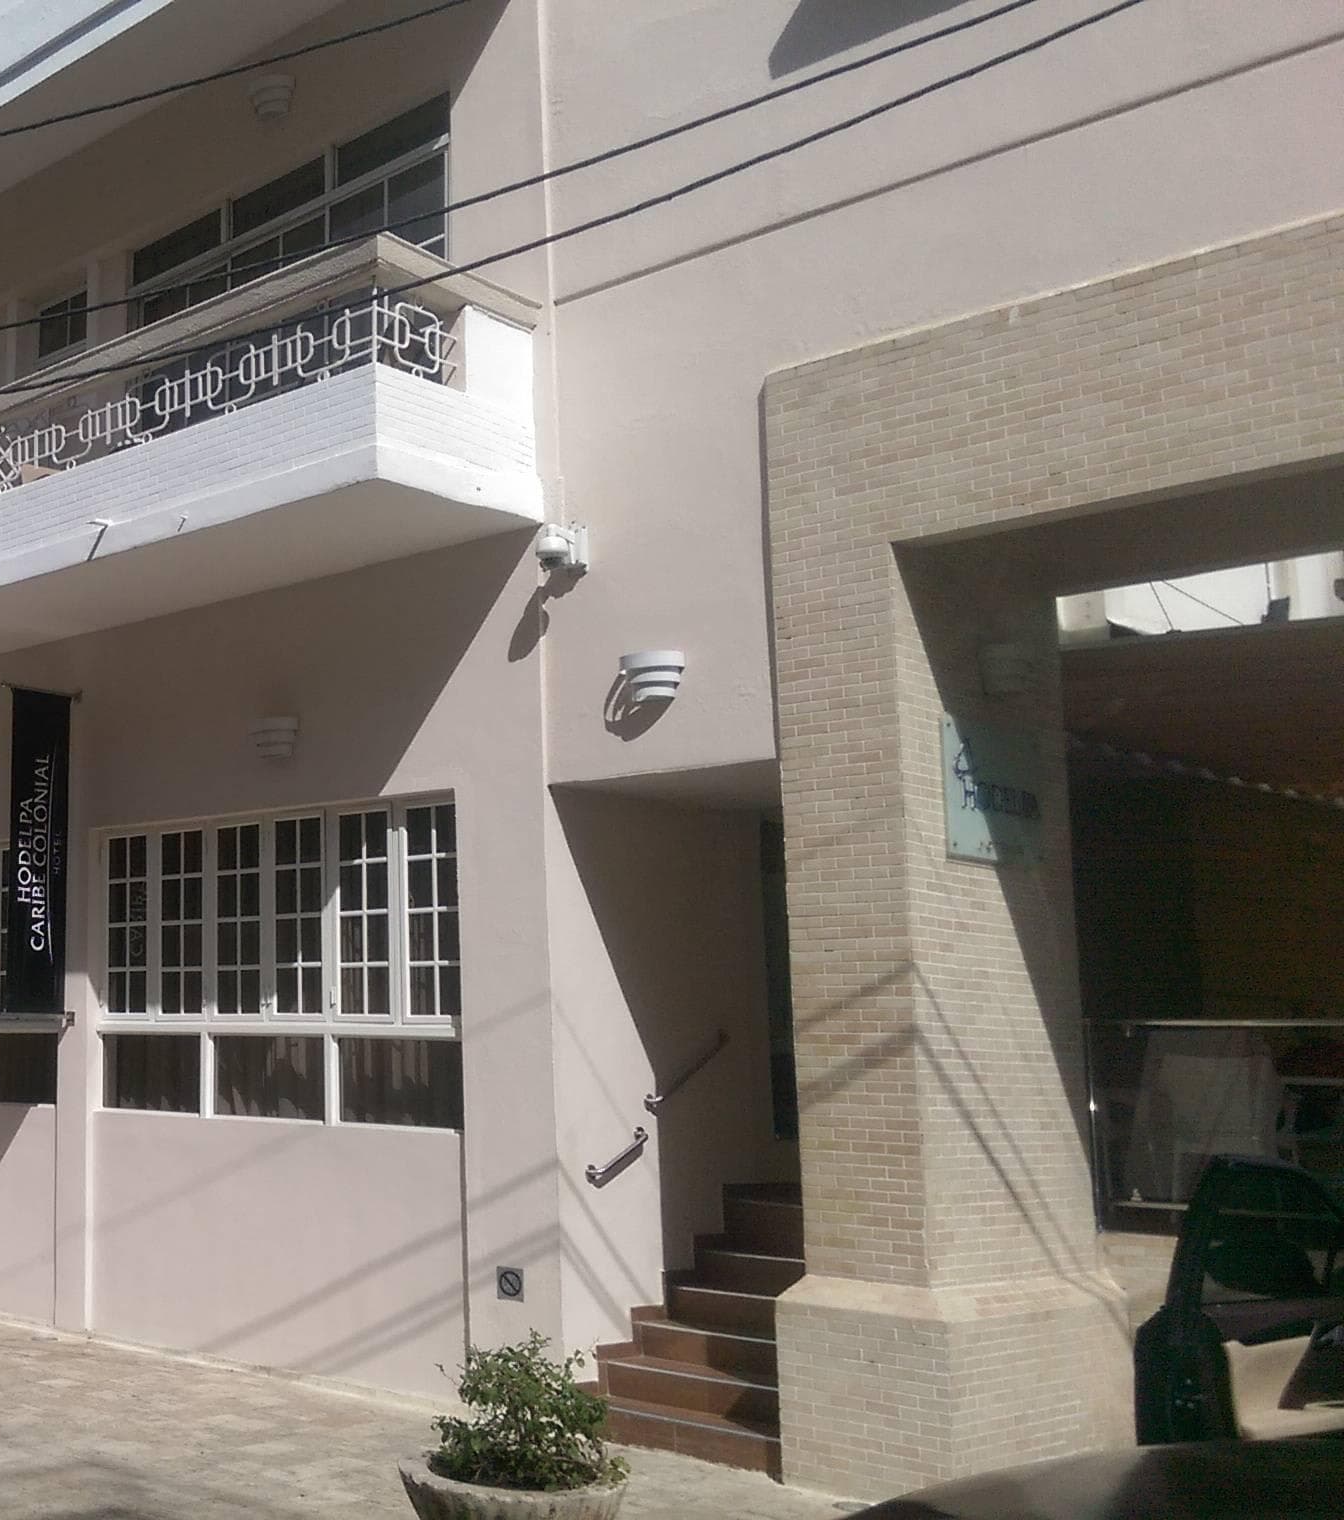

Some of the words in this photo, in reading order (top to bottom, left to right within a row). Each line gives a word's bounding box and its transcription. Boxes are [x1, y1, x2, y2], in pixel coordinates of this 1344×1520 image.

[17, 798, 33, 902] HODELPA
[32, 754, 49, 867] COLONIAL
[52, 831, 62, 875] HOTEL
[30, 872, 46, 951] CARIBE
